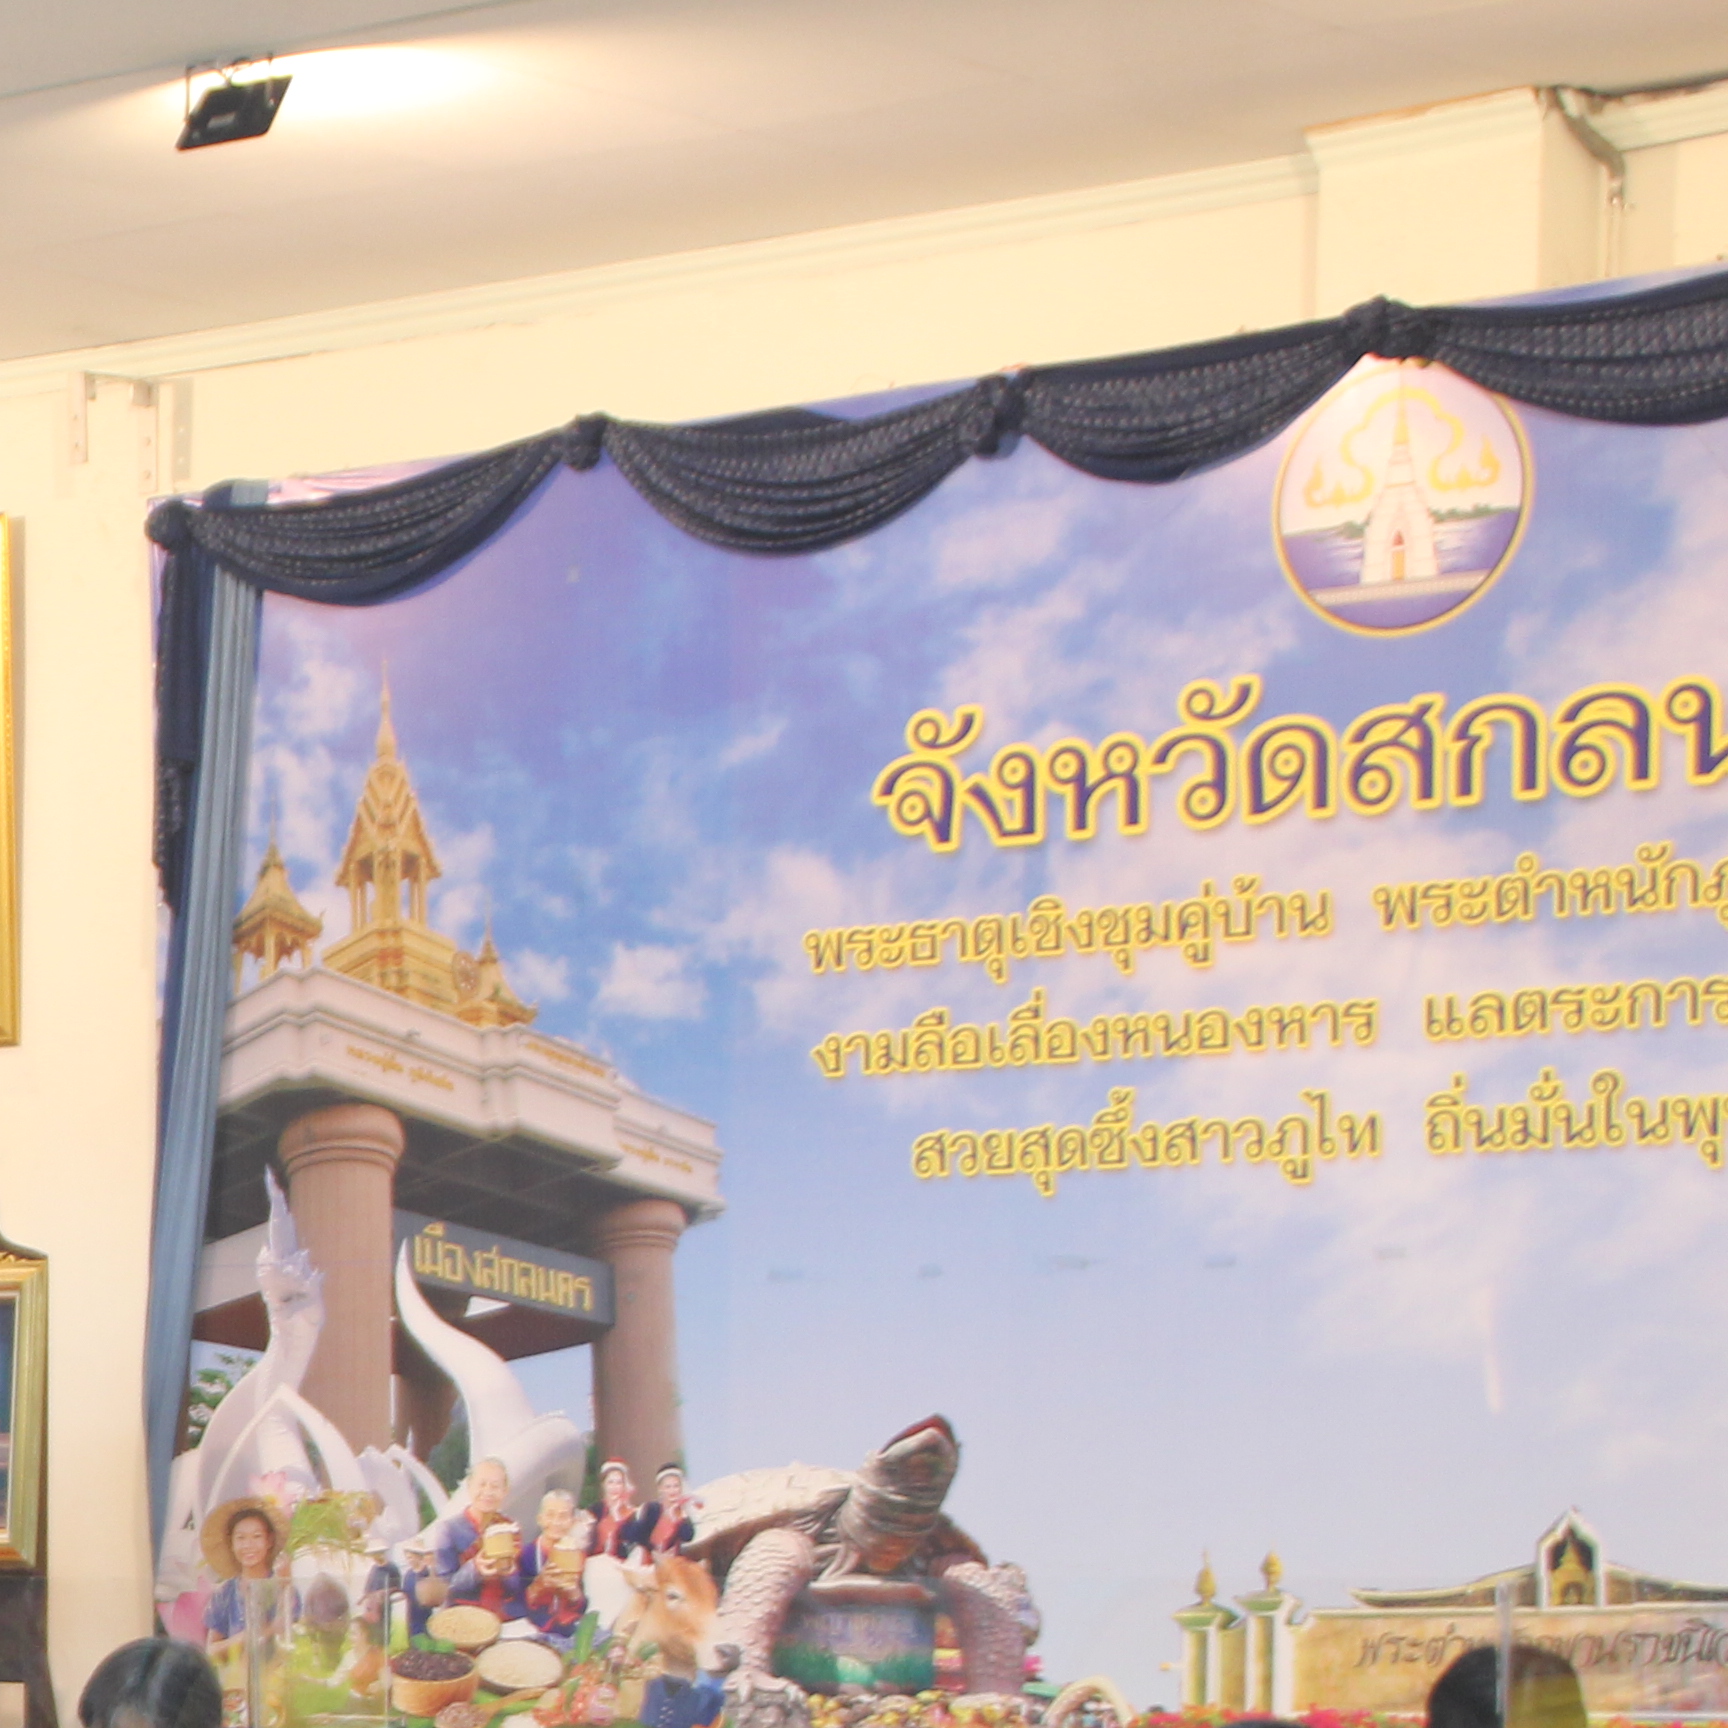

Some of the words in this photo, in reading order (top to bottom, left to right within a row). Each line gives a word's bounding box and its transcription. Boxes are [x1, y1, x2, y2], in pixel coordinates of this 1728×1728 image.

[804, 875, 1332, 983] พระธาตุเชิงชุมคู่บ้าน
[812, 988, 1377, 1078] งามลือเลื่องหนองหาร
[912, 1086, 1382, 1196] สวยสุดซึ้งสาวภูไท
[1425, 1066, 1728, 1171] ถิ่นมั่นในพุ
